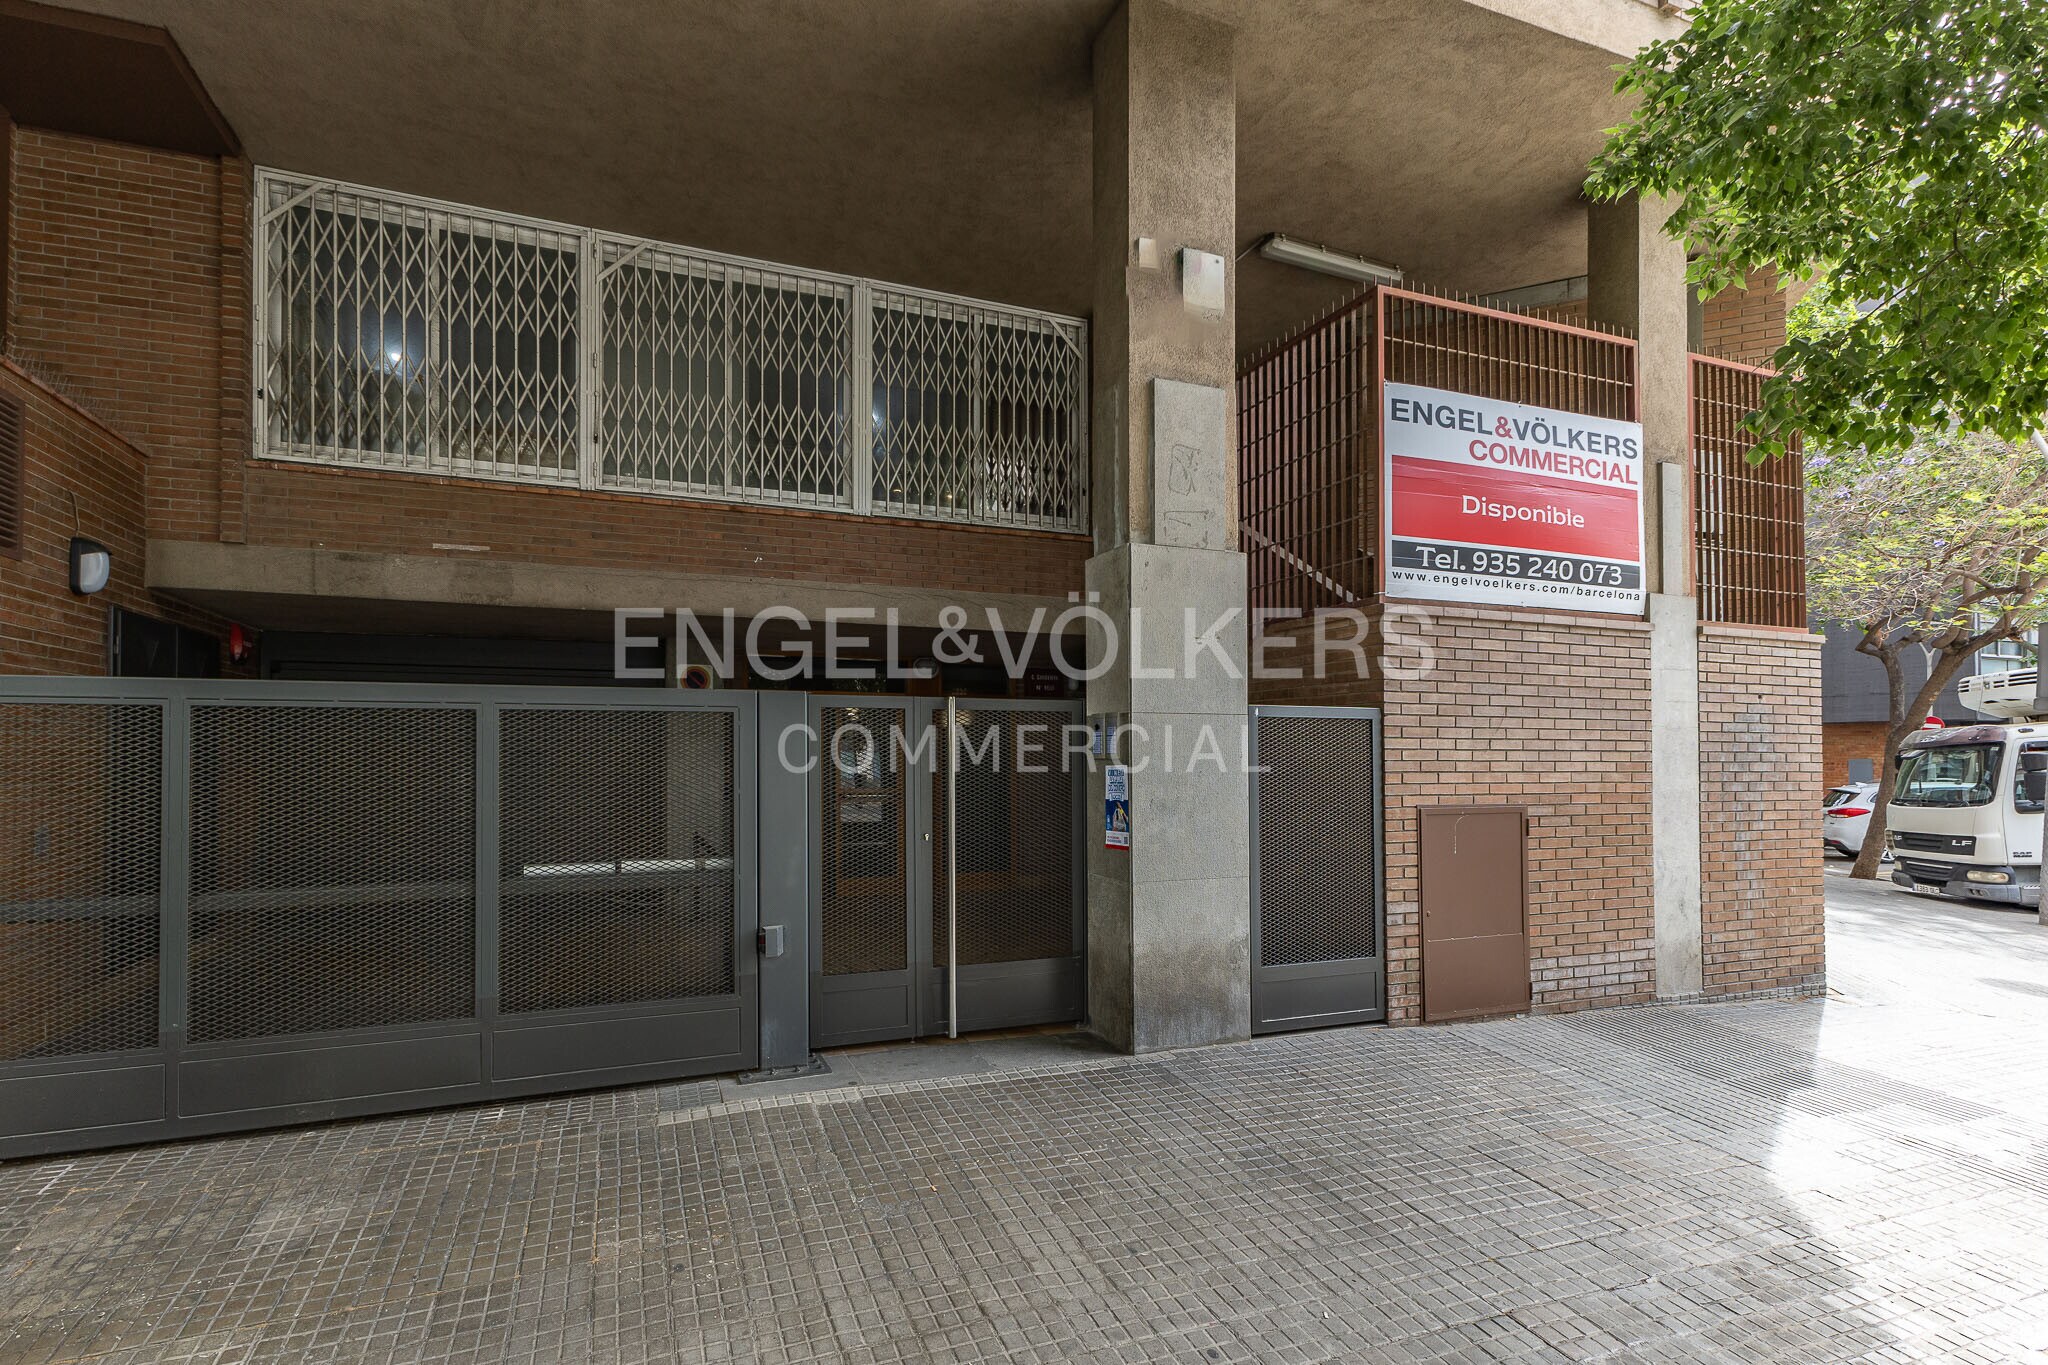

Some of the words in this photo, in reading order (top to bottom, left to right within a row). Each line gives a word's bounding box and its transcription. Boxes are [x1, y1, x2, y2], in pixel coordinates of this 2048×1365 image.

[1391, 398, 1638, 460] ENGEL&VÖLKERS
[1469, 439, 1638, 485] COMMERCIAL
[1461, 495, 1585, 528] Disponible
[1415, 545, 1467, 571] Tel.
[1472, 551, 1521, 576] 935
[1527, 556, 1574, 580] 240
[1579, 562, 1623, 586] 073
[1392, 570, 1641, 601] www.engelvoelkers.com/barcelona
[1951, 839, 1973, 847] LF
